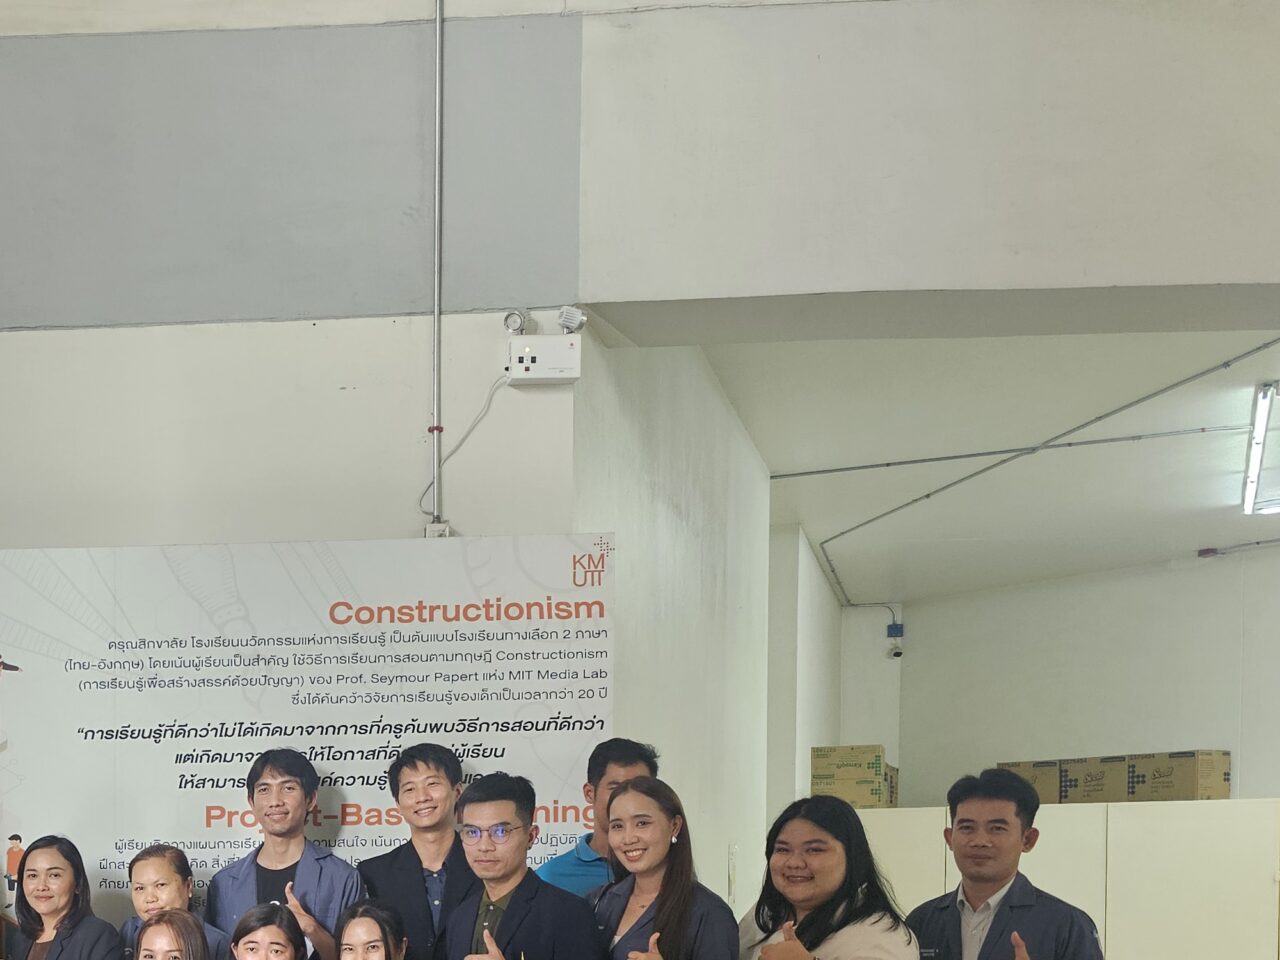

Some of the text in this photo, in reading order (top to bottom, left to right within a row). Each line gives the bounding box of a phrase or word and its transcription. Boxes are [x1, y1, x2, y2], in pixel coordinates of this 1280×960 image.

[329, 595, 605, 625] Constructionism
[108, 637, 187, 653] ดรุณสิกขาลัย
[191, 631, 386, 649] โรงเรียนนวัตกรรมแห่งการเรียนรู้
[562, 629, 571, 640] 2
[575, 628, 608, 640] ภาษา
[496, 649, 608, 662] Constructionism
[309, 675, 332, 686] ของ
[336, 673, 367, 685] Prof.
[371, 672, 430, 686] Seymour
[434, 671, 479, 686] Papert
[482, 667, 505, 682] แห่ง
[509, 670, 533, 681] MIT
[537, 669, 579, 680] Media
[583, 668, 608, 680] Lab
[578, 688, 594, 699] 20
[598, 686, 608, 699] ปี
